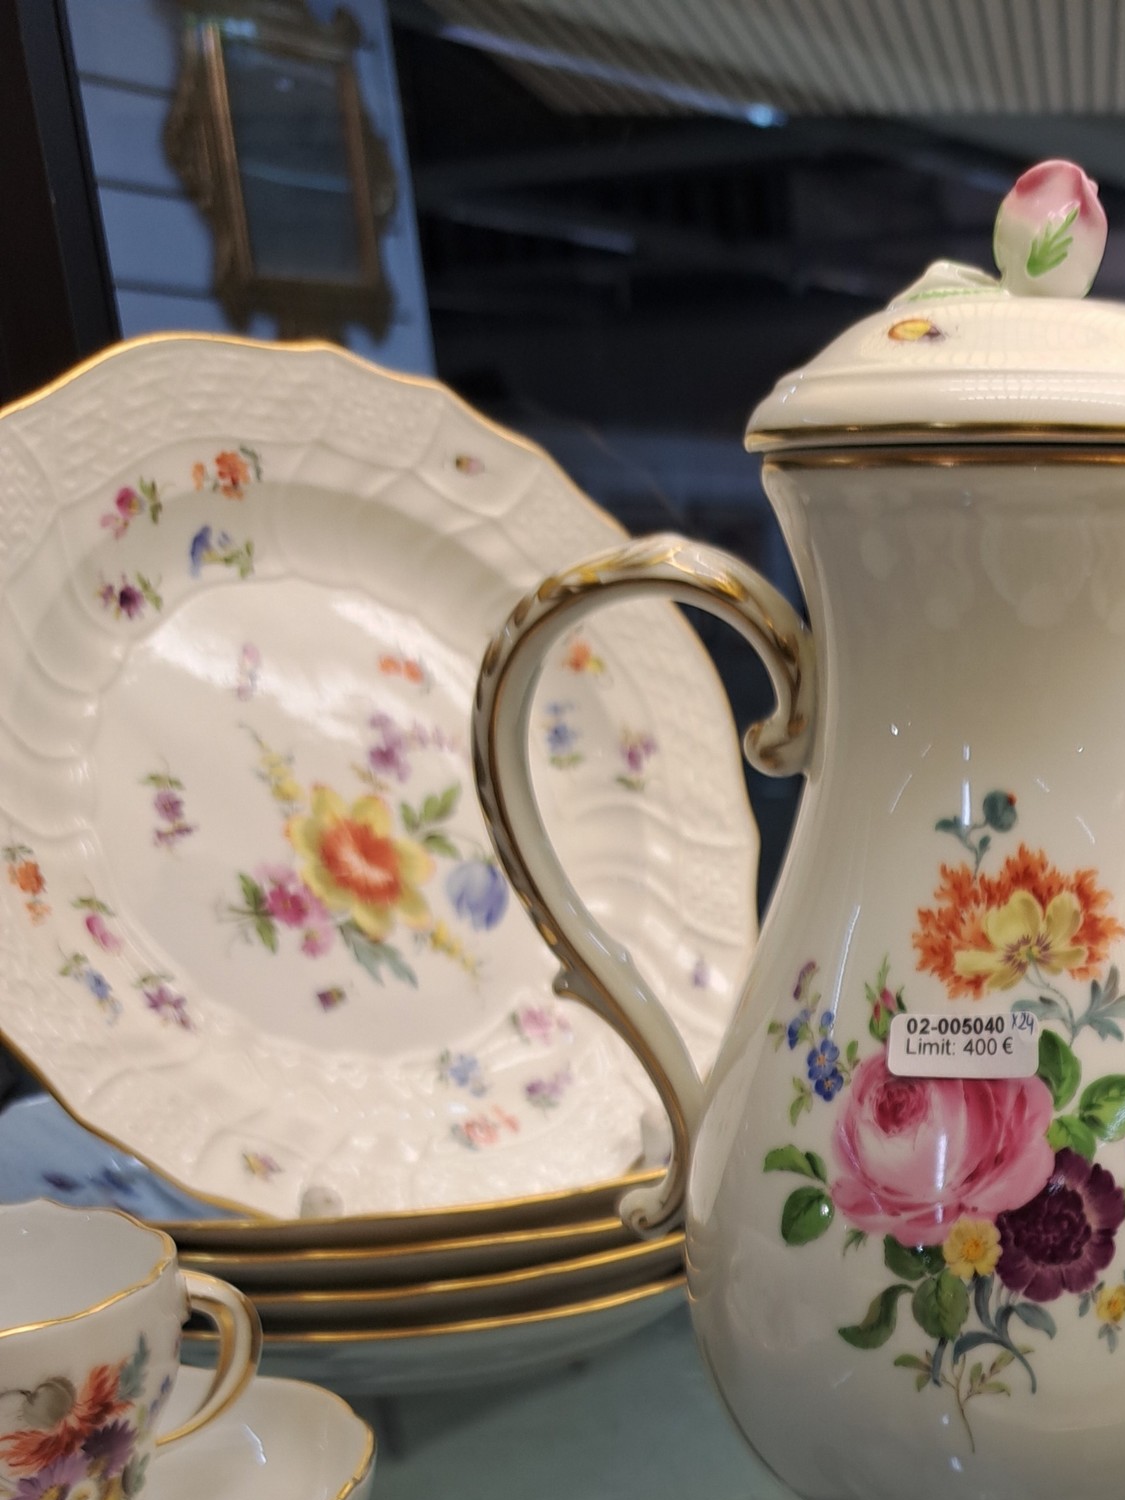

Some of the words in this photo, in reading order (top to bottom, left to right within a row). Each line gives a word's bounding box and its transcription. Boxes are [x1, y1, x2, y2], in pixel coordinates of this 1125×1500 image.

[906, 1016, 1005, 1035] 02-005040
[905, 1037, 956, 1056] Limit:
[963, 1038, 998, 1056] 400
[1002, 1036, 1014, 1055] €
